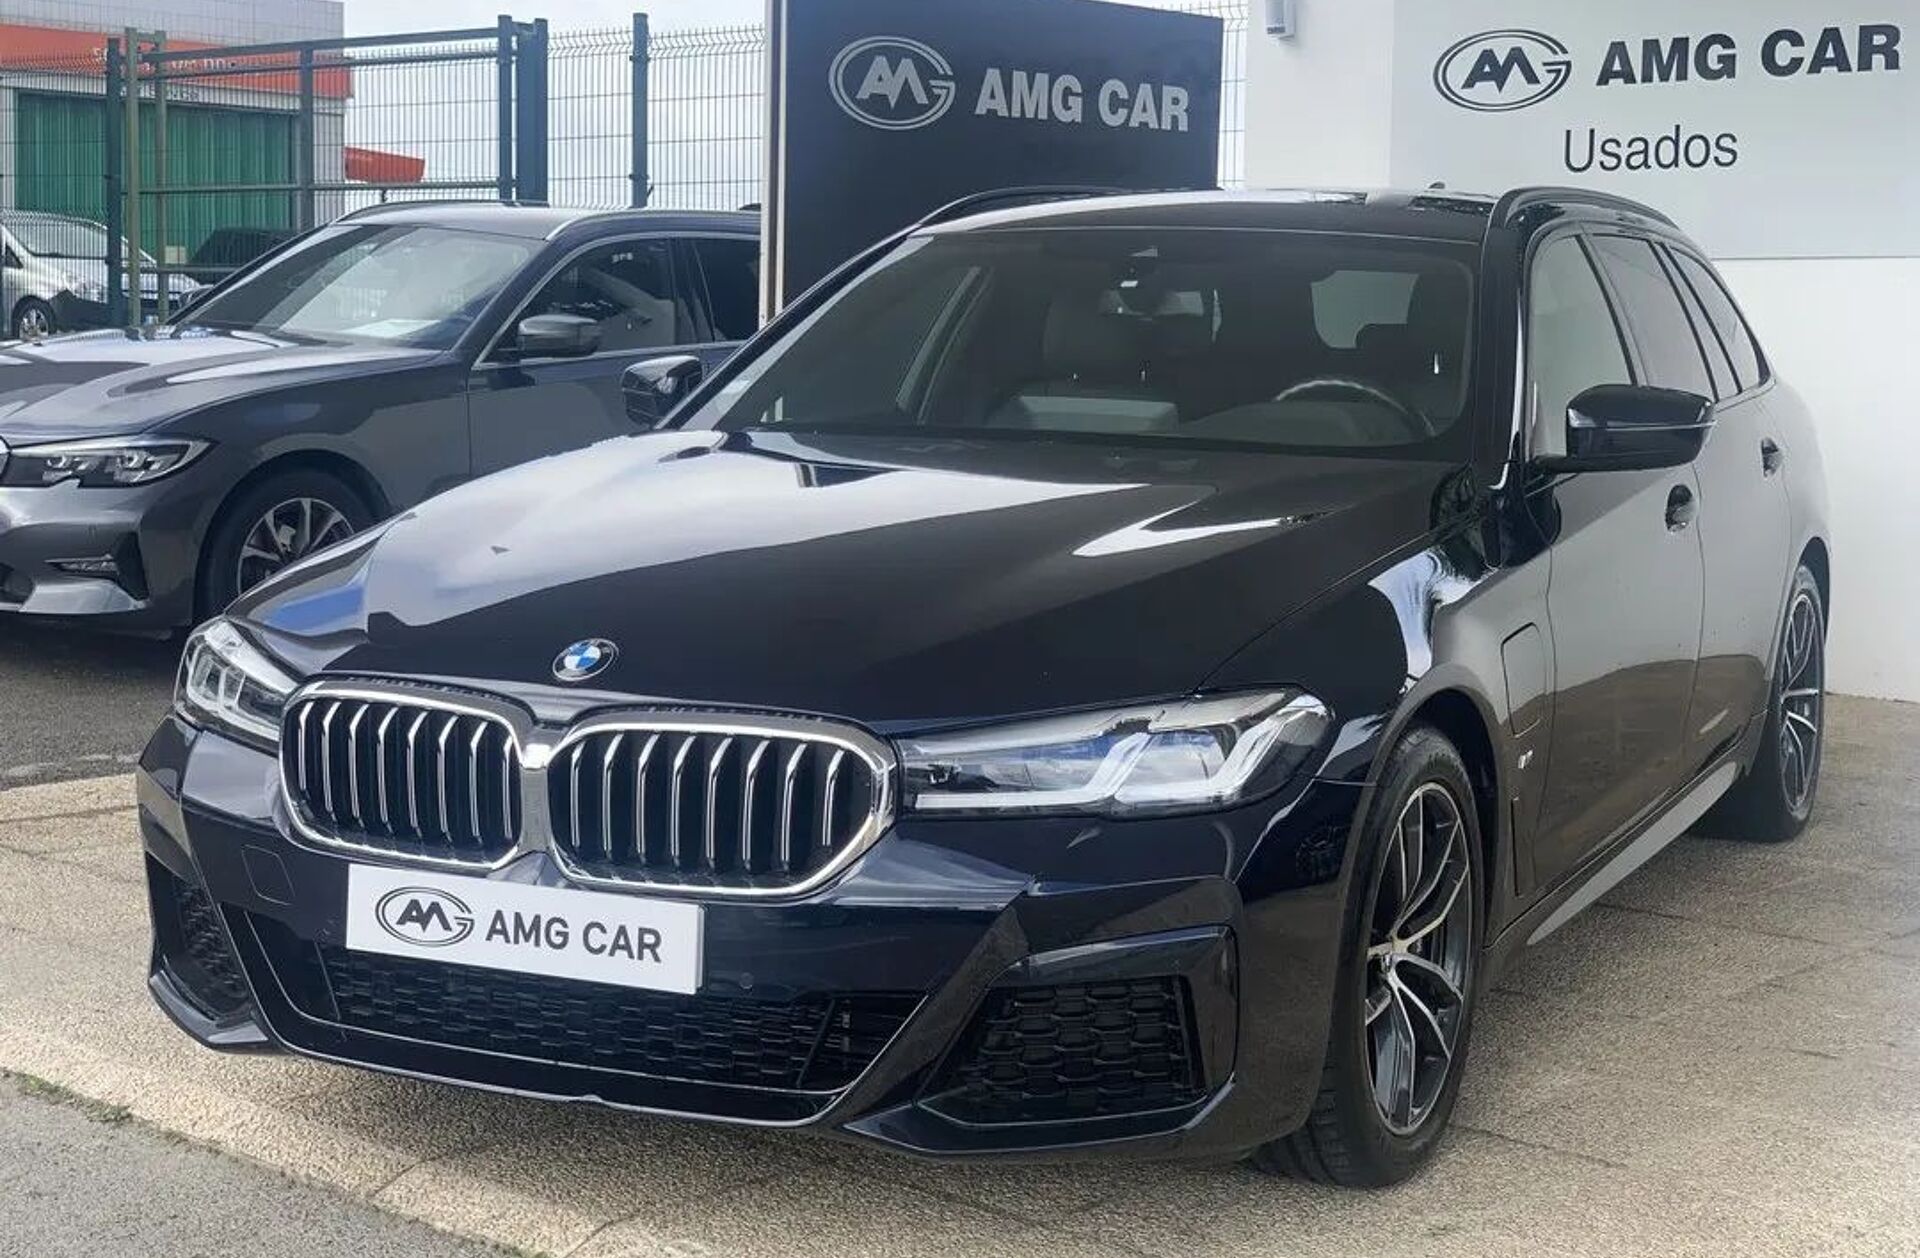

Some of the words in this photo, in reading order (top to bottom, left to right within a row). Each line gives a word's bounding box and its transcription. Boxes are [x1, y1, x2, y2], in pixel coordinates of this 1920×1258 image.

[1596, 33, 1737, 86] AMG
[1761, 24, 1901, 77] CAR
[974, 68, 1083, 123] AMG
[1098, 79, 1189, 131] CAR
[1563, 124, 1738, 173] Usados
[485, 909, 569, 950] AMG
[582, 921, 662, 962] CAR
